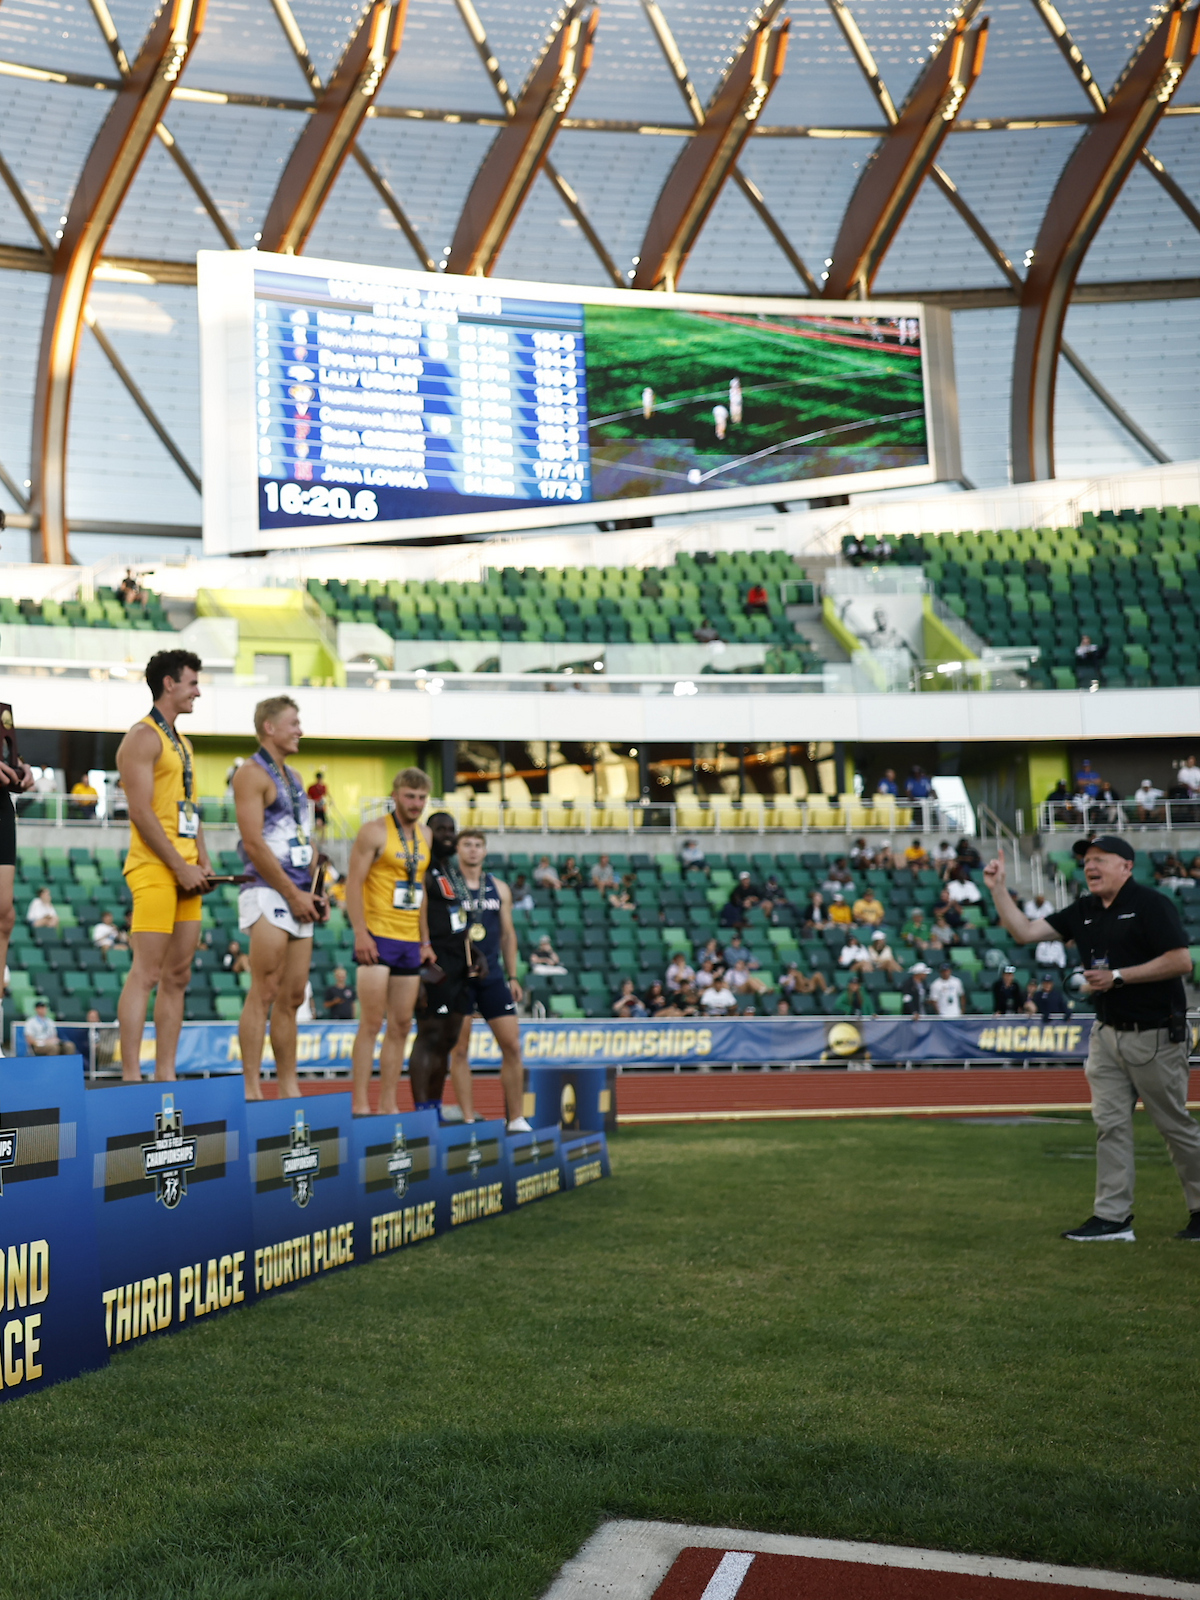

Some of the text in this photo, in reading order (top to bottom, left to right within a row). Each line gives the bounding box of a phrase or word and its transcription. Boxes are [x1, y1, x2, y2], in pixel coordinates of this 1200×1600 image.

[264, 482, 378, 521] 16:20.6
[524, 1029, 712, 1057] CHAMPIONSHIPS
[978, 1025, 1083, 1053] #NCAATF
[146, 1145, 194, 1168] CHAMPIONSHIPS
[451, 1181, 503, 1225] SIXTH PLACE
[371, 1201, 436, 1255] FIFTH PLACE
[254, 1221, 354, 1294] FOURTH PLACE
[102, 1250, 246, 1347] THIRD PLACE
